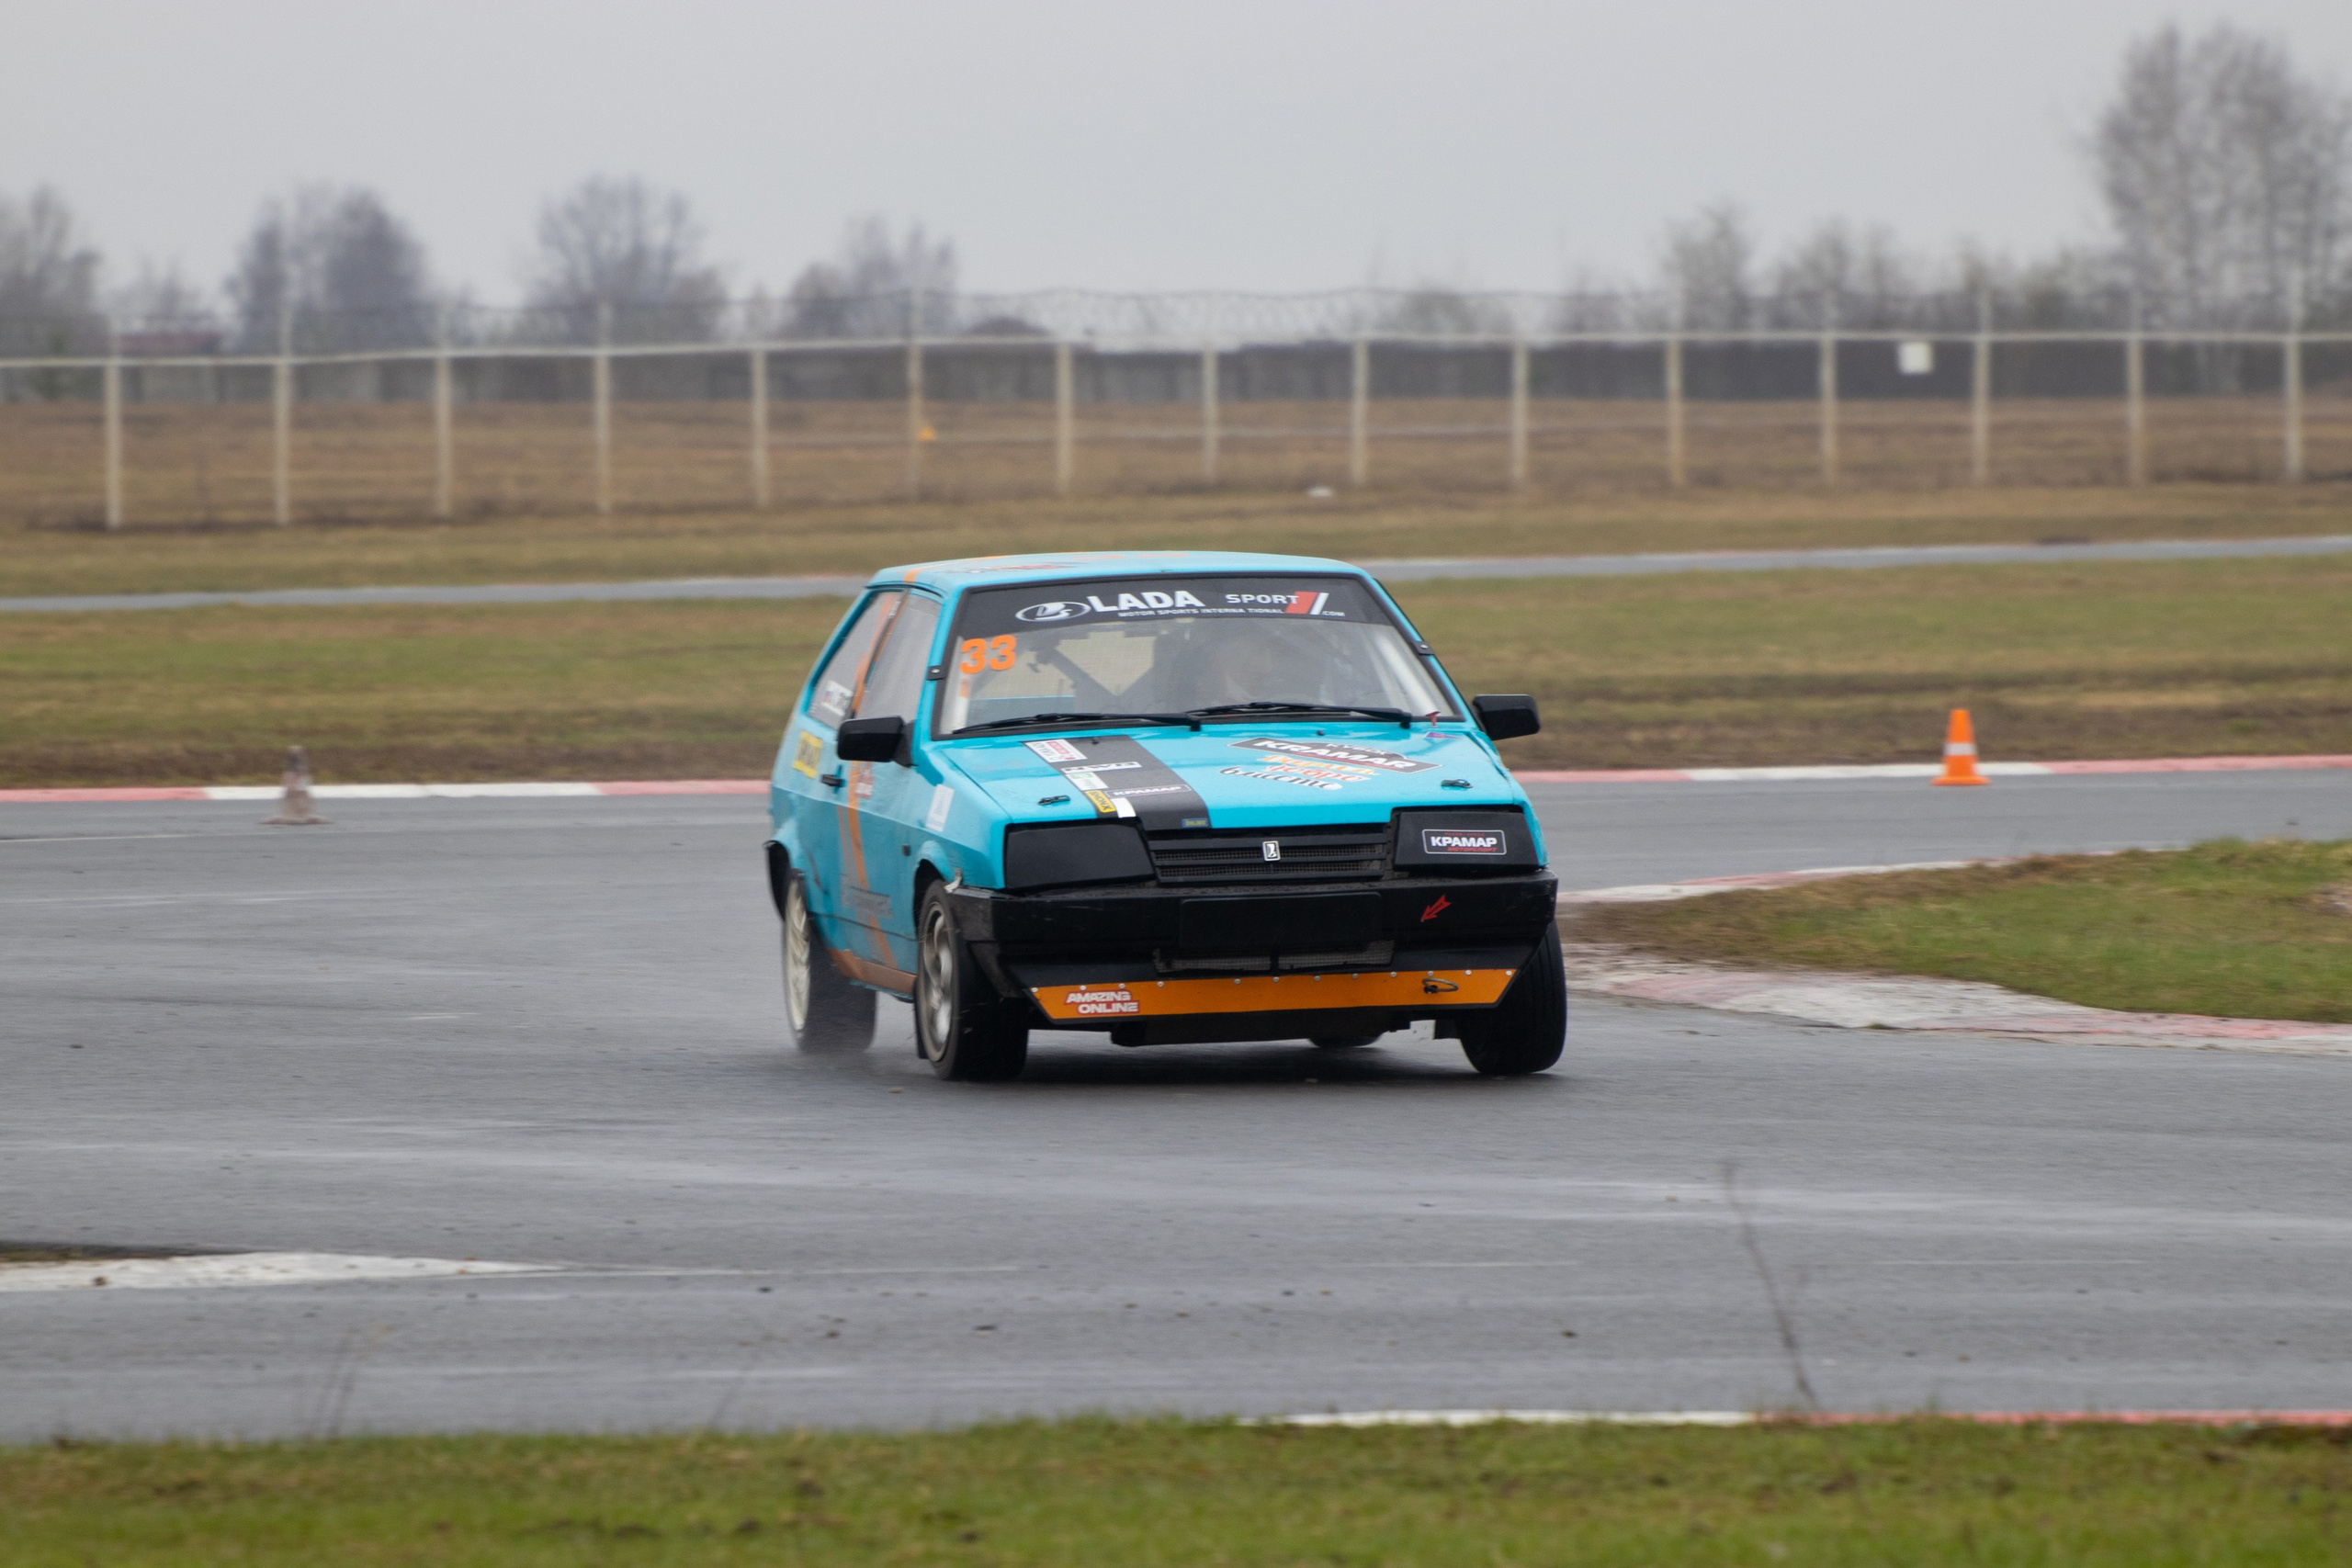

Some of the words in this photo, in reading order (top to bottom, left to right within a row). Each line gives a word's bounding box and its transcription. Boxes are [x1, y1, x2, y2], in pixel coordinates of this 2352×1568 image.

[1087, 591, 1206, 612] LADA
[1225, 594, 1300, 604] SPORT
[959, 634, 1017, 675] 33
[1252, 739, 1417, 769] KRAMAR
[1430, 836, 1498, 848] КРАМАР
[1066, 991, 1131, 1004] AMAZING
[1078, 1002, 1138, 1014] ONLINE
